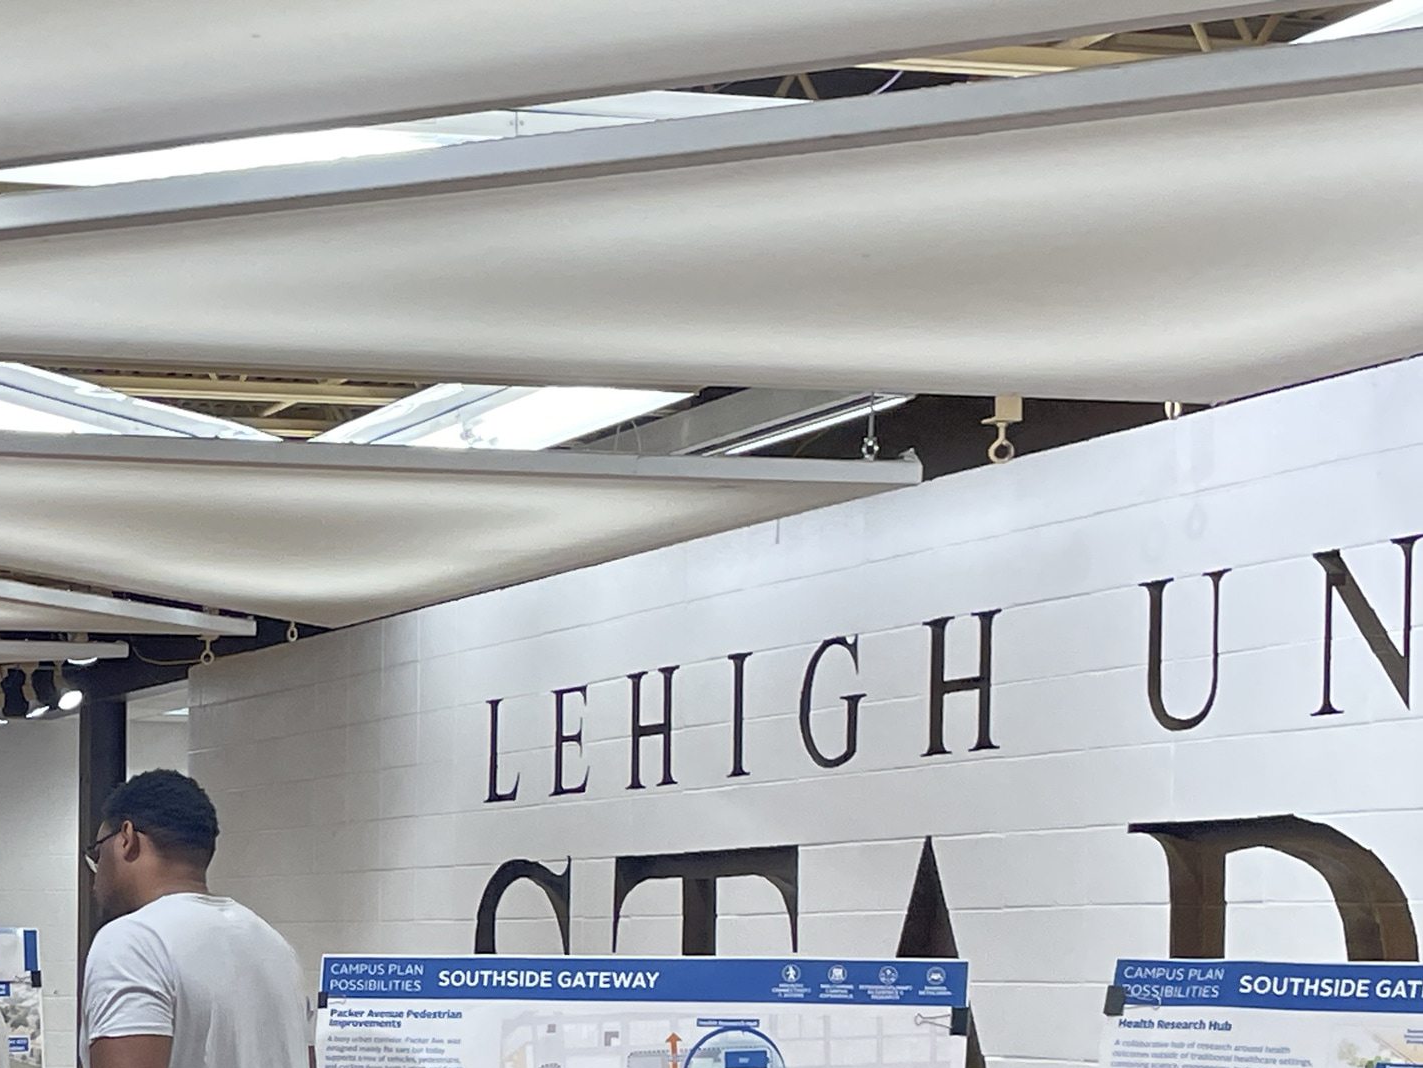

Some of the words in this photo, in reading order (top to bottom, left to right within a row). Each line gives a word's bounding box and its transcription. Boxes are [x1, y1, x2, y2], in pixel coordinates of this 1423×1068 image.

[483, 607, 1002, 804] LEHIGH
[330, 963, 385, 976] CAMPUS
[388, 964, 424, 976] PLAN
[1123, 966, 1184, 981] CAMPUS
[1188, 967, 1224, 981] PLAN
[330, 979, 422, 992] POSSIBILITIES
[438, 970, 552, 987] SOUTHSIDE
[557, 971, 660, 989] GATEWAY
[1238, 974, 1371, 998] SOUTHSIDE
[1123, 983, 1220, 998] POSSIBILITIES
[330, 1009, 364, 1018] Packer
[367, 1010, 404, 1018] Avenue
[406, 1010, 462, 1019] Pedestrian
[329, 1019, 401, 1028] Improvements
[1118, 1019, 1155, 1030] Health
[1157, 1020, 1206, 1031] Research
[1208, 1021, 1232, 1032] Hub
